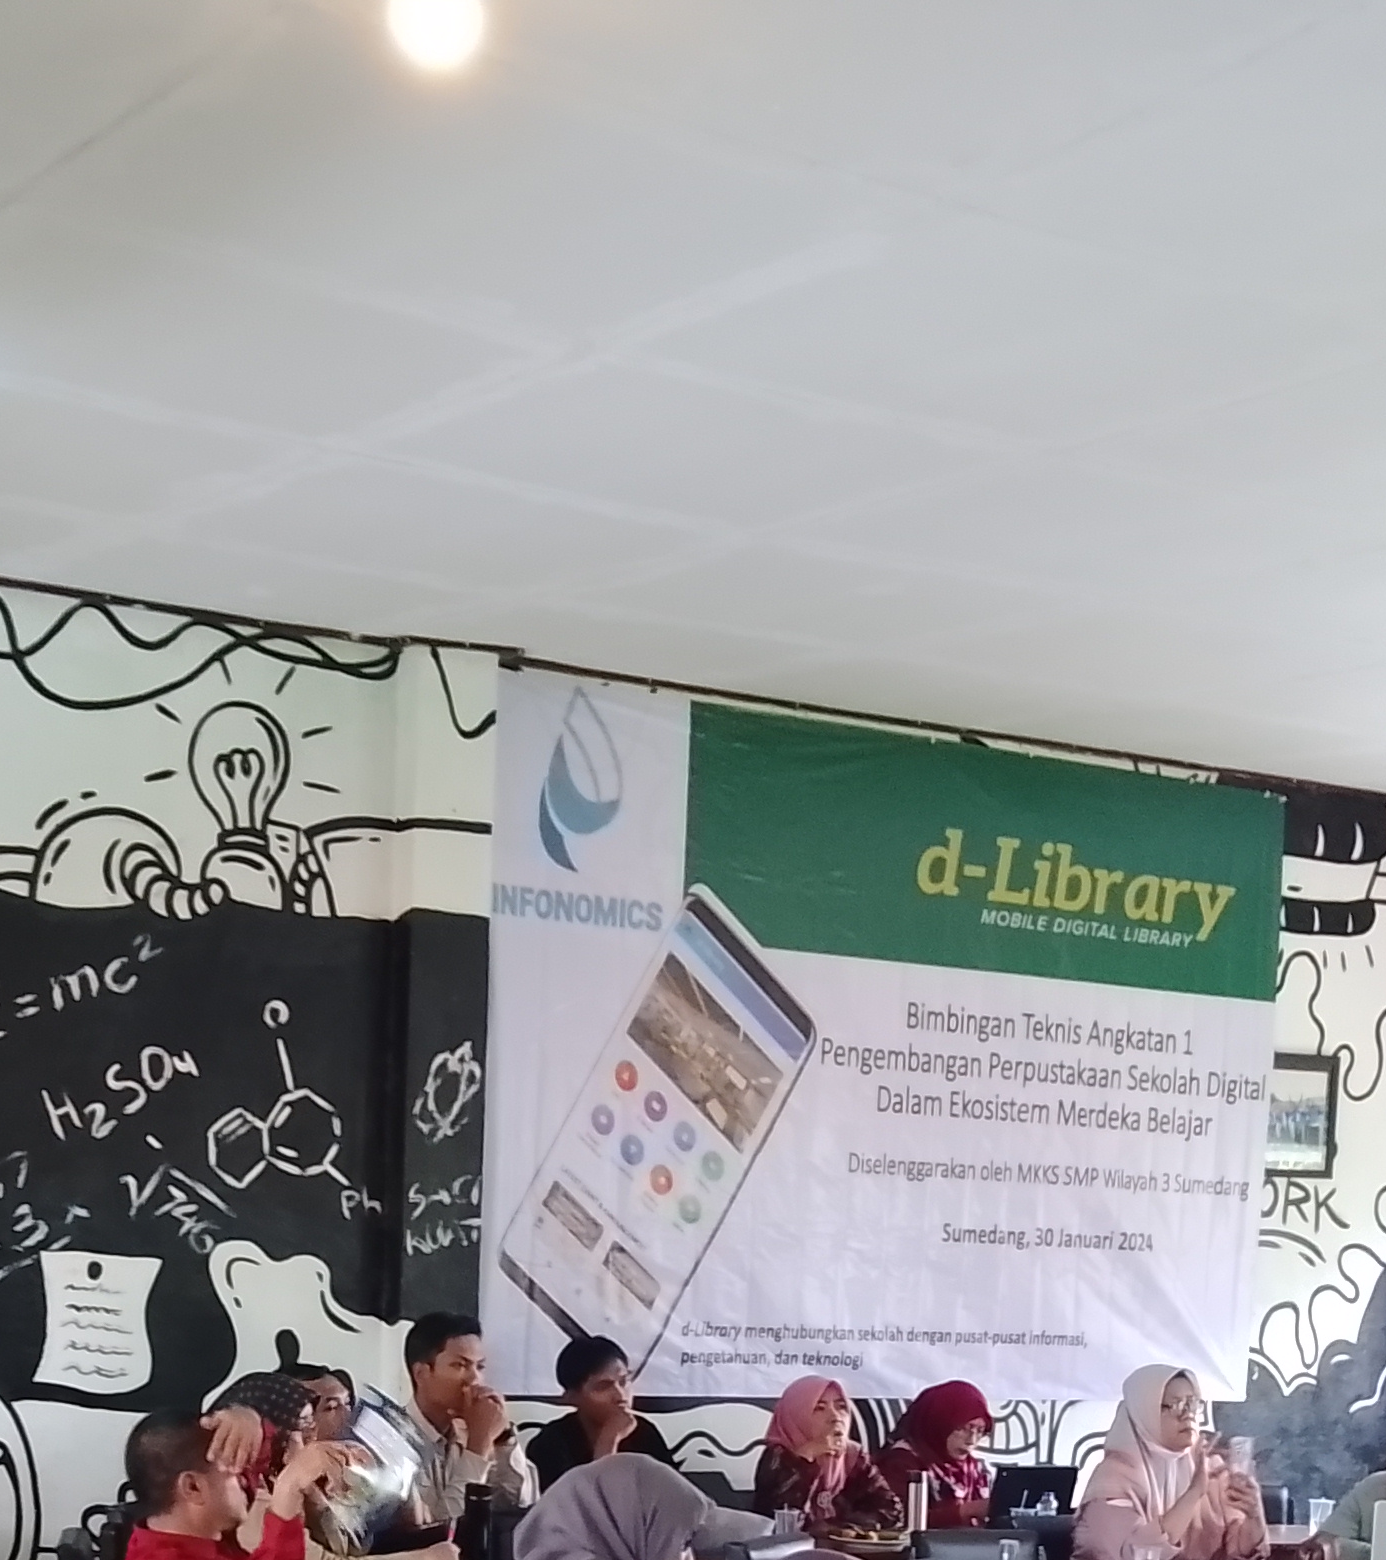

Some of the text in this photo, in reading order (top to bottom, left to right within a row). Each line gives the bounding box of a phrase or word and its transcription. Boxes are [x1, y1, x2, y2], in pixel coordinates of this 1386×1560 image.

[492, 883, 663, 931] INFONOMICS
[917, 827, 1237, 941] d-Library
[981, 909, 1193, 948] MOBILE DIGITAL LIBRARY
[906, 1001, 1193, 1055] Bimbingan Teknis Angkatan 1
[821, 1037, 1266, 1105] Pengembangan Perpustakaan Sekolah Digital
[877, 1085, 1213, 1142] Dalam Ekosistem Merdeka Belajar
[848, 1152, 1250, 1201] Diselenggarakan oleh MKKS SMP Wilayah 3 Sumedang
[941, 1223, 1153, 1251] Sumedang, 30 Januari 2024
[681, 1321, 1088, 1348] d-Library menghubungkan sekolah dengan pusat-pusat informasi,
[680, 1350, 863, 1370] pengetahuan, dan teknologi
